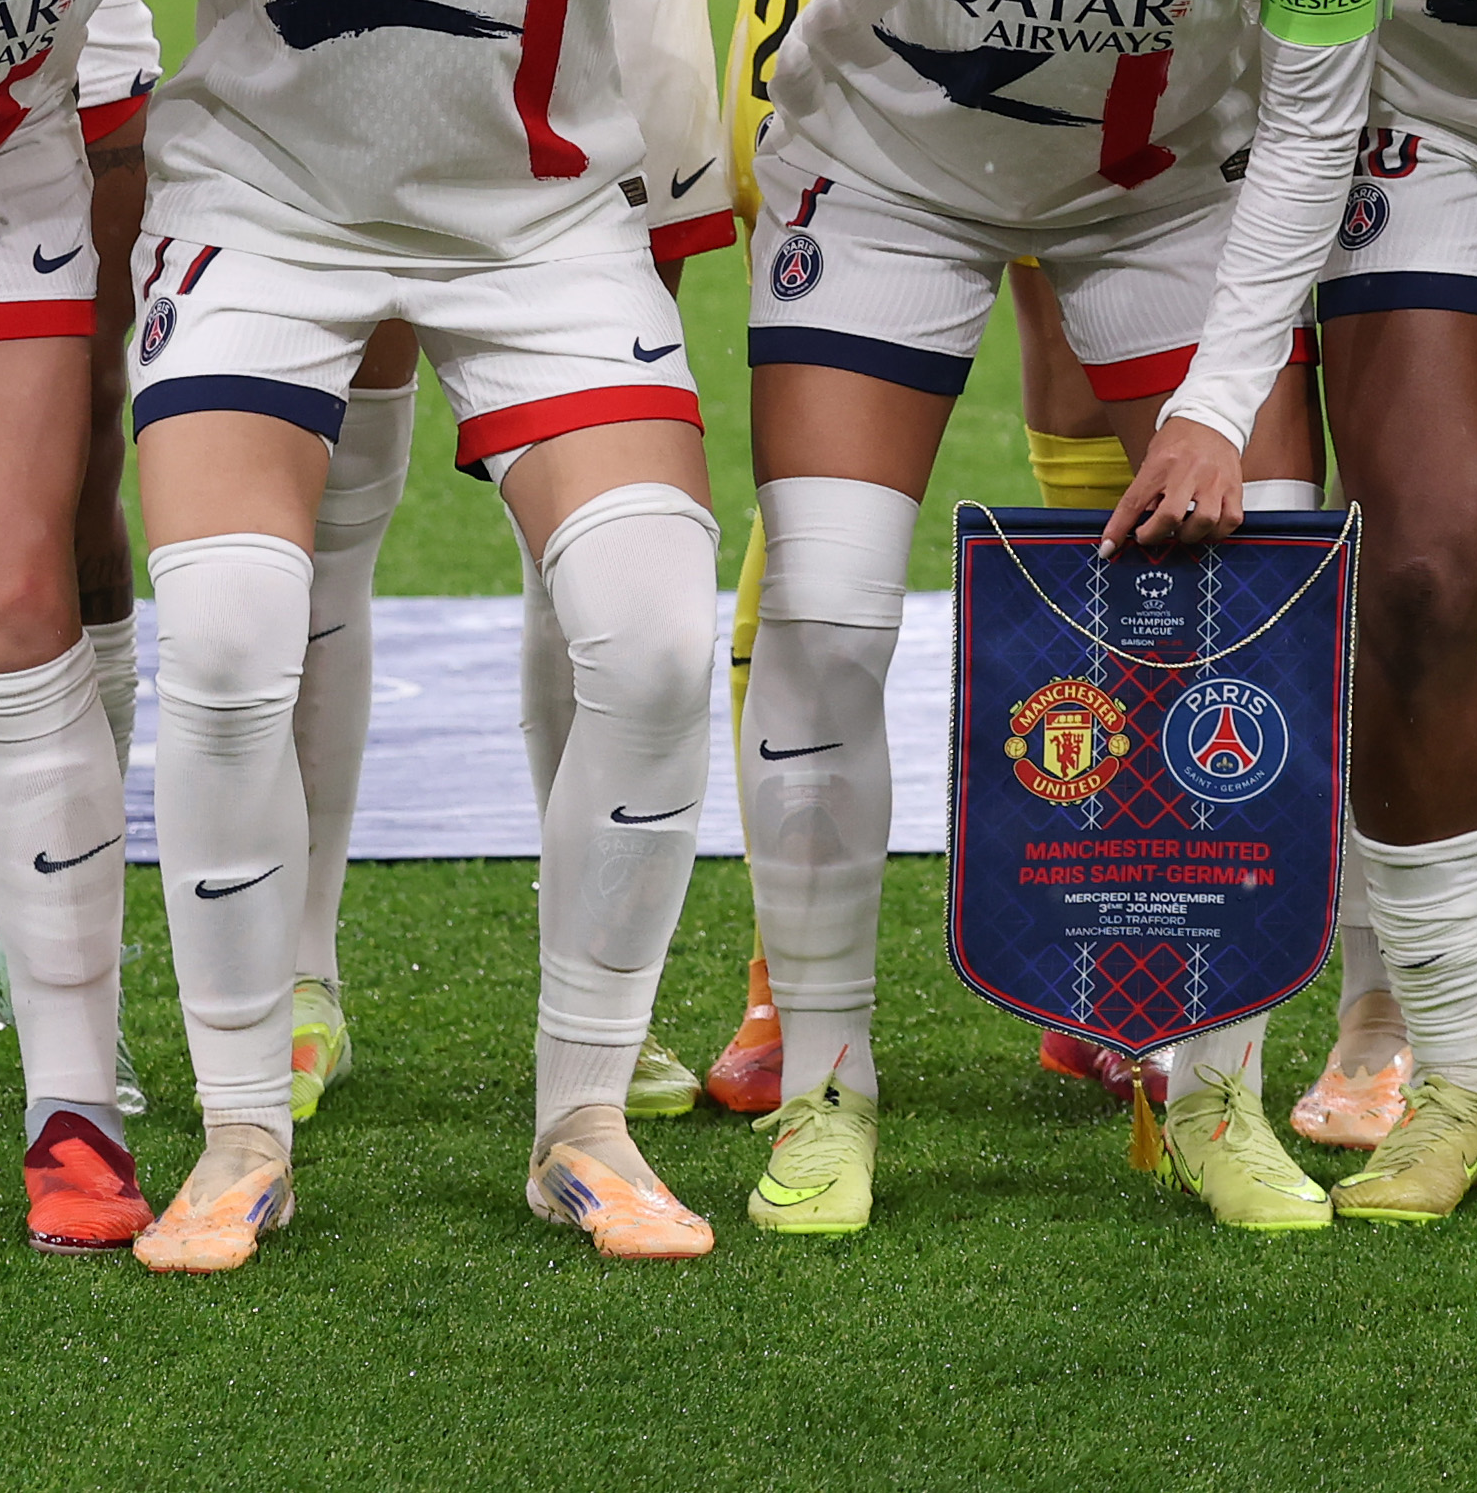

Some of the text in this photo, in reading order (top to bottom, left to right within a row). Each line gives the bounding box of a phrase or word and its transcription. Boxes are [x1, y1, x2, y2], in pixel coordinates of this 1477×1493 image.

[983, 20, 1174, 54] AIRWAYS
[783, 240, 815, 256] PARIS
[1120, 617, 1184, 626] CHAMPIONS
[1133, 627, 1172, 636] LEAGUE
[1121, 638, 1154, 646] SAISON
[1019, 685, 1117, 728] MANCHESTER
[1186, 684, 1268, 716] PARIS
[1032, 774, 1102, 797] UNITED
[1184, 766, 1266, 792] SAINT GERMAIN
[1026, 840, 1271, 862] MANCHESTER UNITED
[1019, 864, 1274, 886] PARIS SAINT-GERMAIN
[1064, 892, 1224, 904] MERCREDI 12 NOVEMBRE
[1126, 902, 1188, 914] JOURNÉE
[1099, 916, 1186, 926] OLD TRAFFORD
[1065, 927, 1221, 938] MANCHESTER, ANGLETERRE
